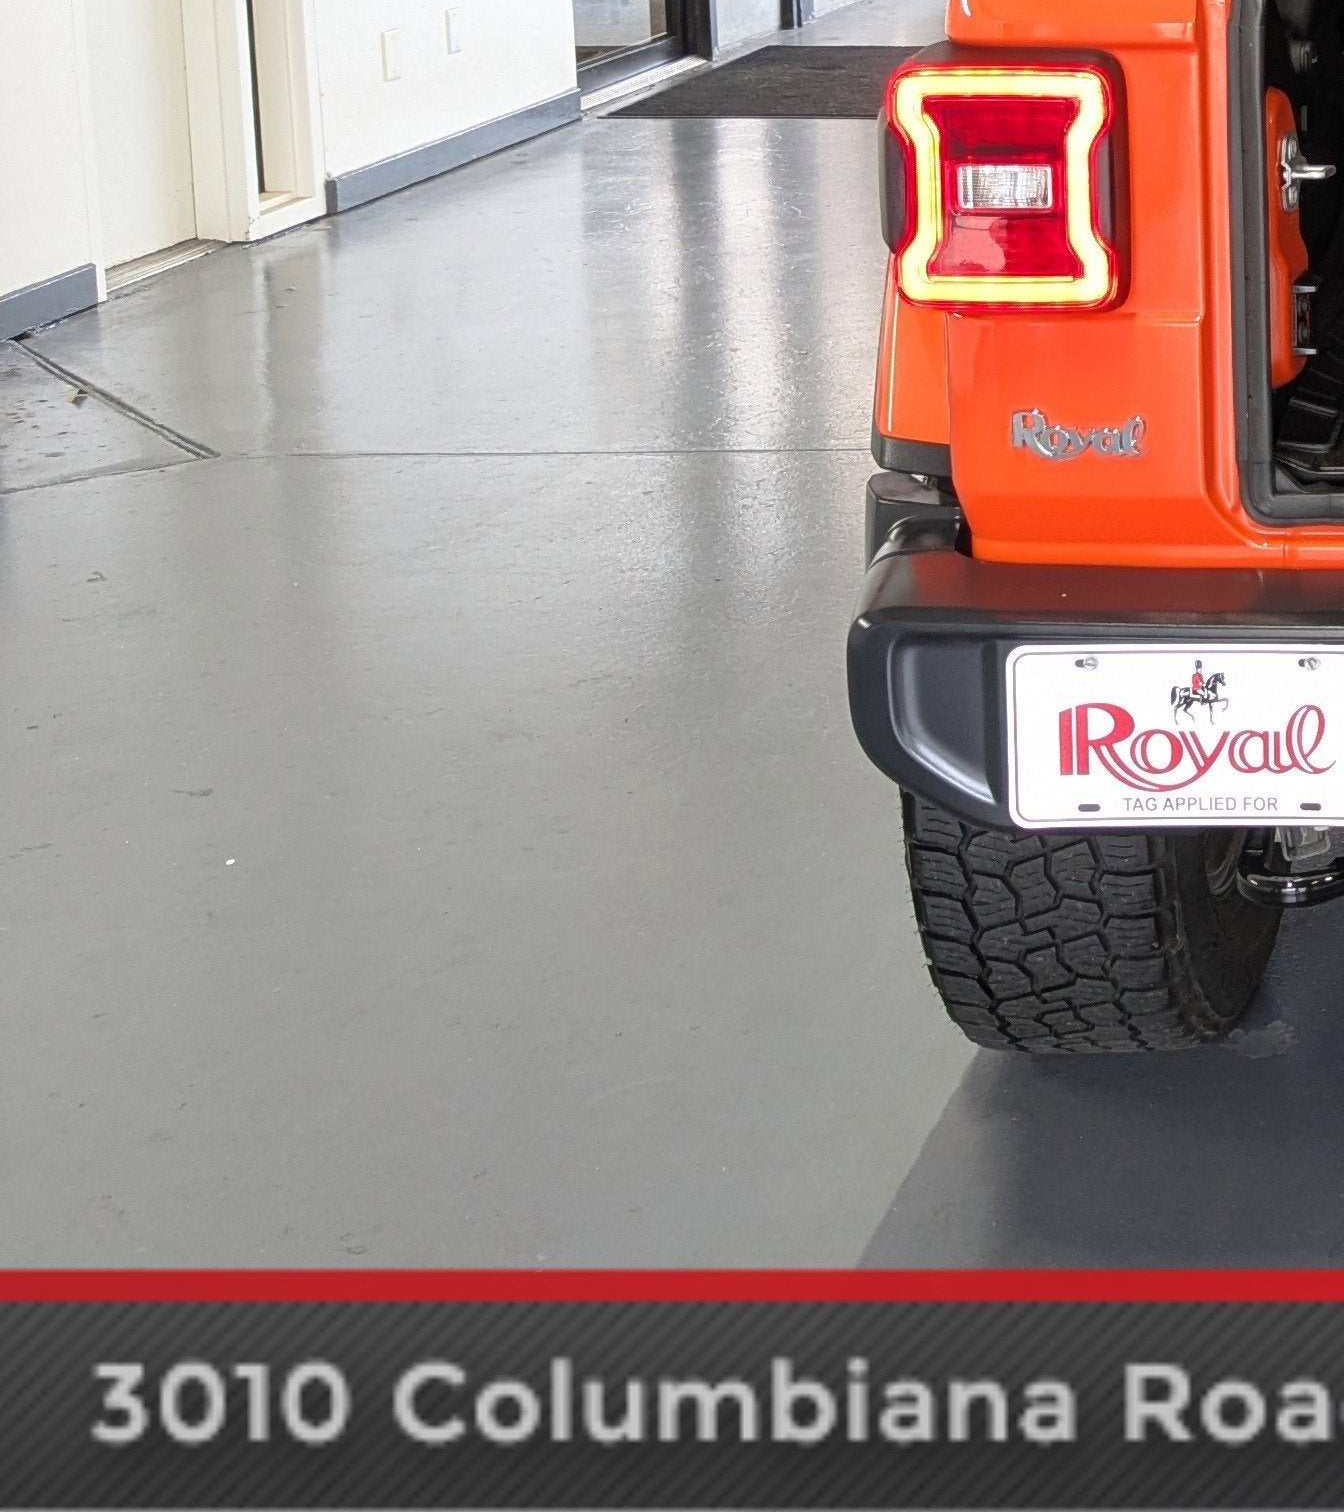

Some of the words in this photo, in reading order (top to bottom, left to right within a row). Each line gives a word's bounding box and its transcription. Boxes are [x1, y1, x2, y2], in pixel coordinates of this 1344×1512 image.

[1012, 408, 1148, 461] Royal
[1059, 703, 1337, 793] Royal
[1123, 797, 1157, 812] TAG
[1162, 796, 1237, 811] APPLIED
[1243, 796, 1279, 811] FOR
